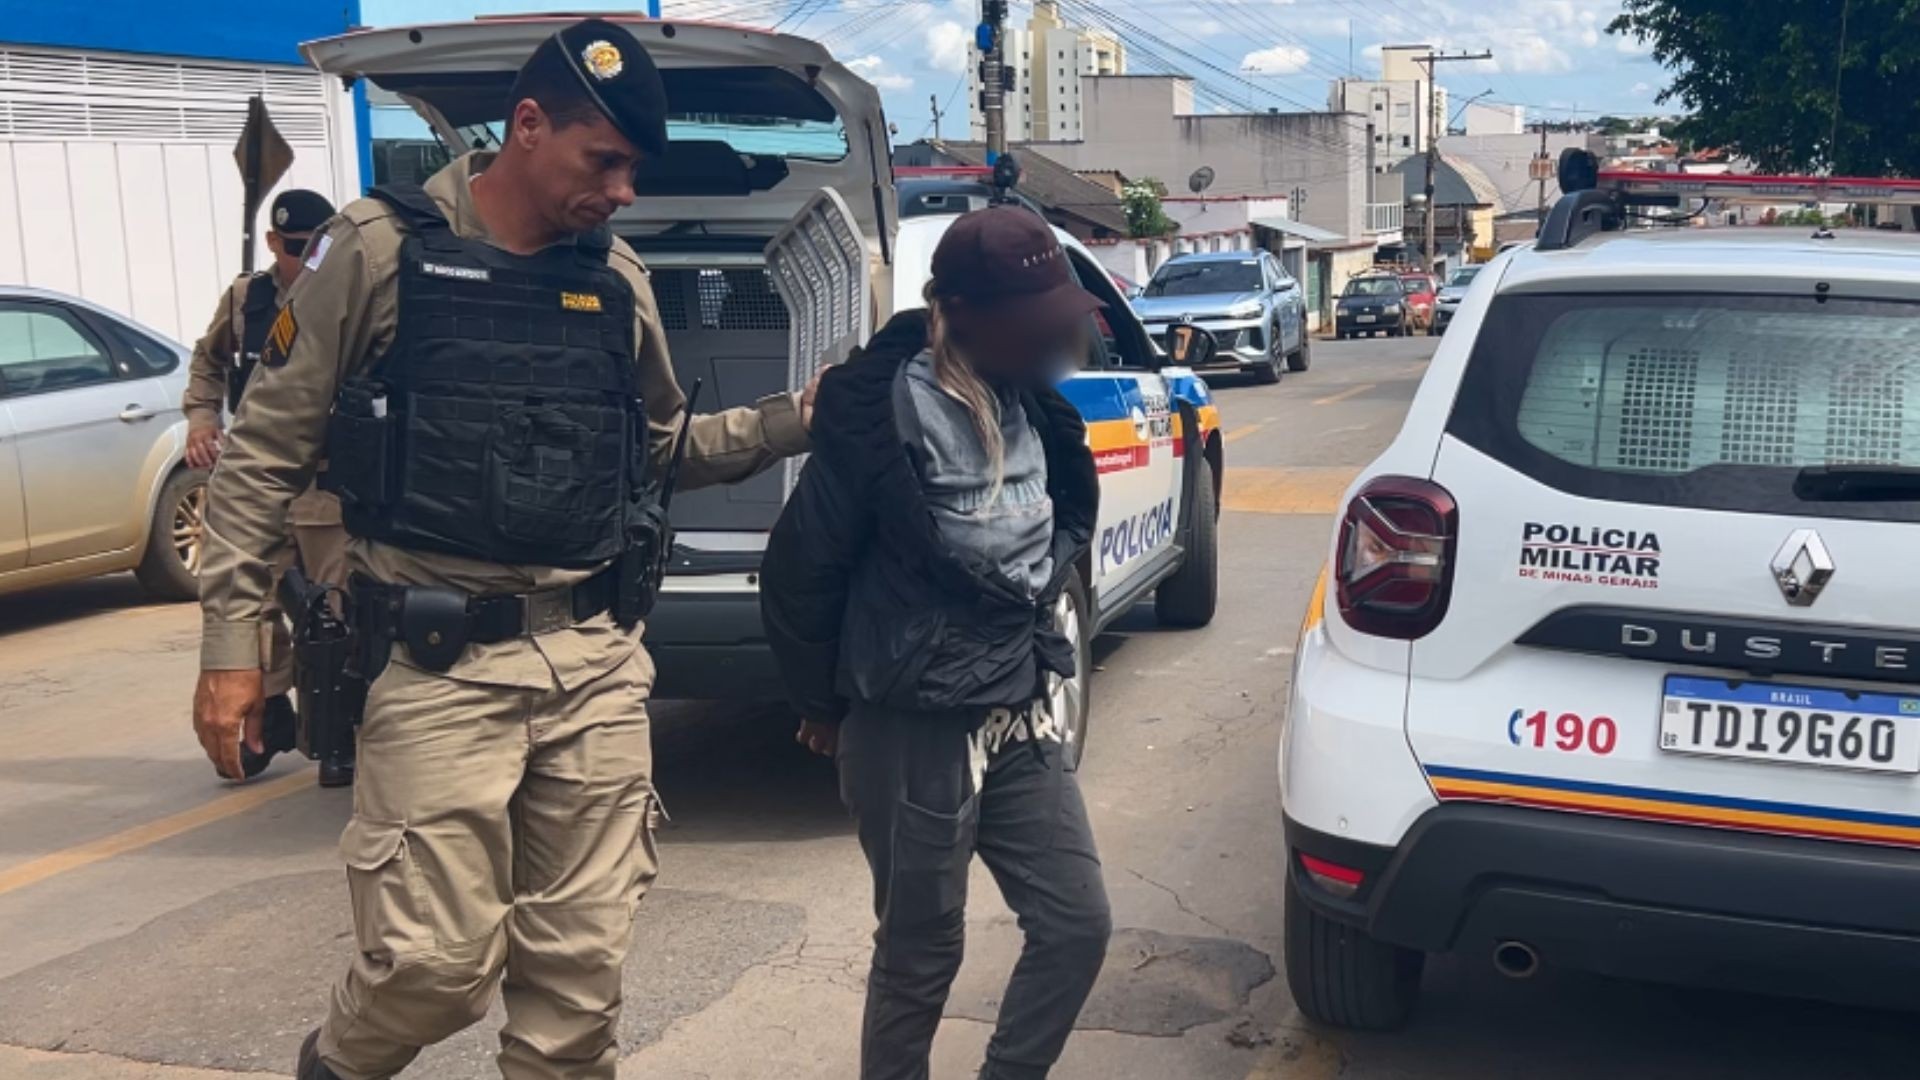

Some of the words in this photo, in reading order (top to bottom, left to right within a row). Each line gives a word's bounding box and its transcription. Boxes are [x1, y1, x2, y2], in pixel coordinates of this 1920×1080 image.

[1520, 548, 1660, 577] MILITAR
[1519, 568, 1538, 579] DE
[1543, 571, 1592, 584] MINAS
[1598, 575, 1659, 588] GERAIS
[1770, 692, 1812, 705] BRASIL
[1526, 710, 1617, 755] 190
[1687, 702, 1896, 763] TDI9G60
